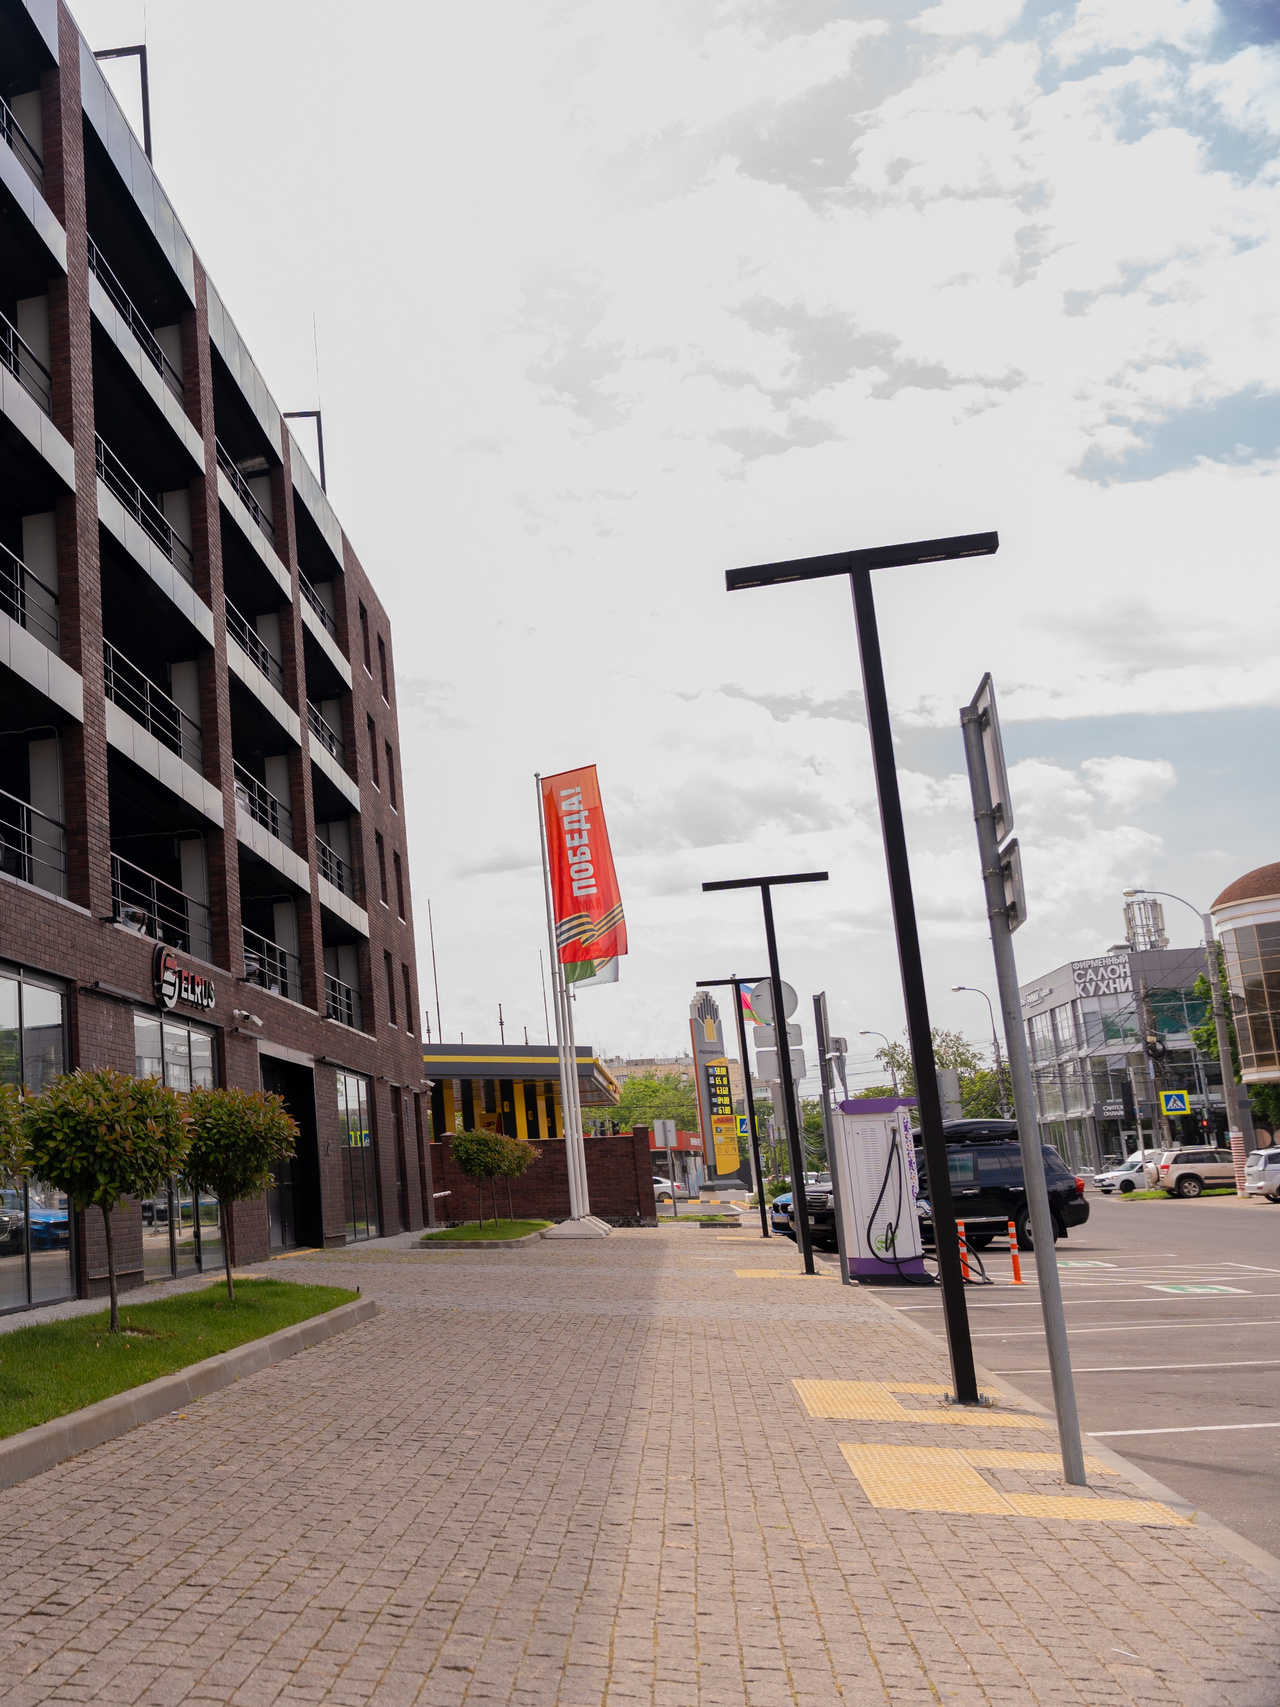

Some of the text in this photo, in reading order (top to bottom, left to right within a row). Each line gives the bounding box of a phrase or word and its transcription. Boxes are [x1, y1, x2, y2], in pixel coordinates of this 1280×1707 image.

[560, 786, 598, 897] ПОБЕДА!
[1072, 953, 1129, 970] ФИРМЕННЫЙ
[1073, 963, 1131, 983] САЛОН
[179, 969, 216, 1009] ELRUS
[1075, 976, 1134, 998] КУХНИ
